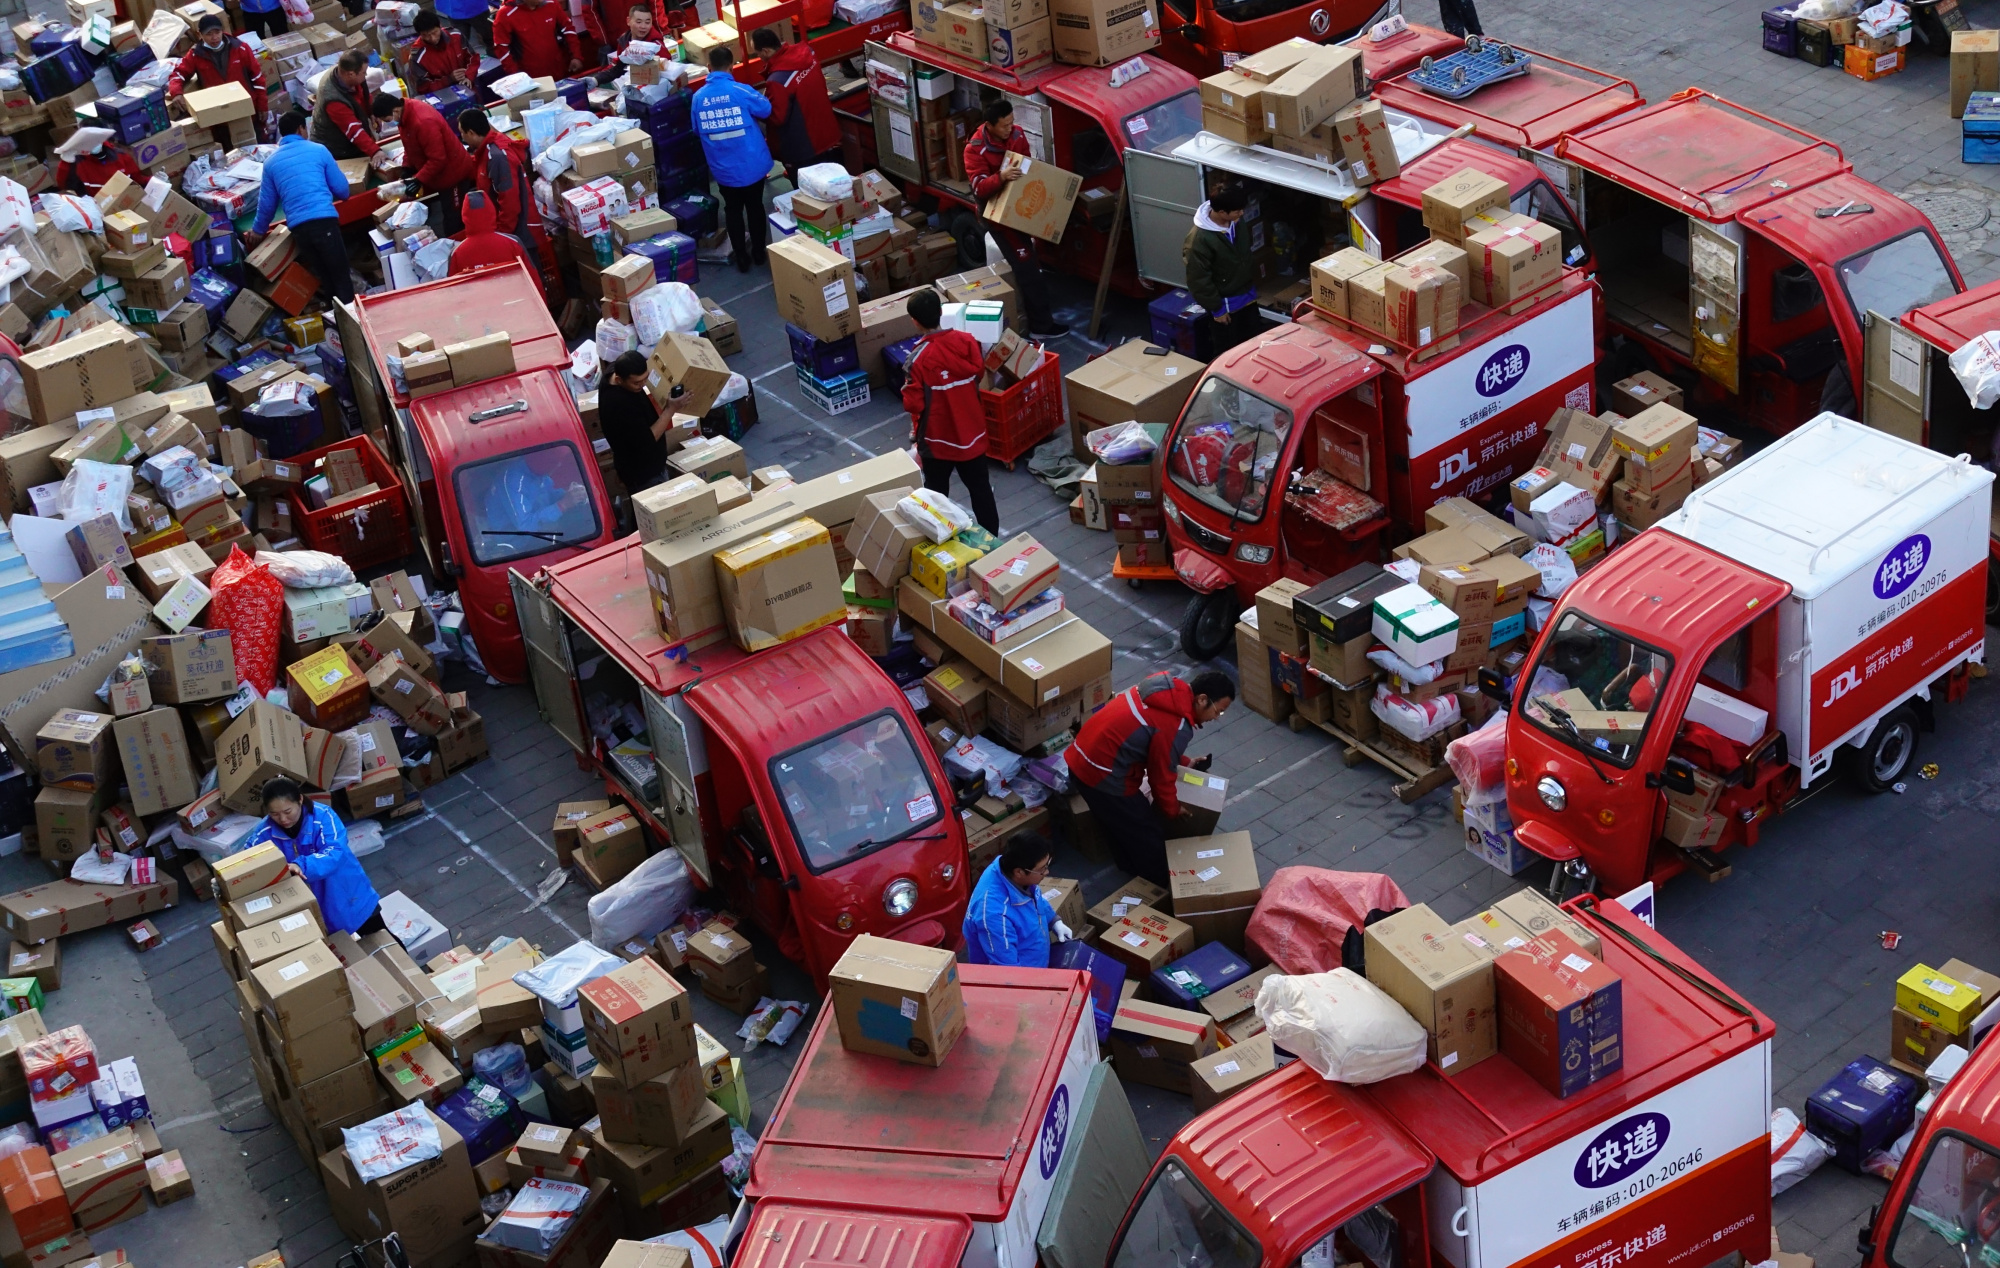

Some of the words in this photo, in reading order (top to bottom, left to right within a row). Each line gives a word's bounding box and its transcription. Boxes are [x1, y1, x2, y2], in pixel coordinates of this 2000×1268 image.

[699, 106, 741, 120] 着急送东西
[701, 116, 744, 130] 叫达达快送
[1482, 350, 1524, 392] 快递
[1459, 401, 1502, 430] 车辆编码:
[1480, 430, 1503, 446] Express
[1481, 421, 1538, 463] 京东快递
[1430, 448, 1478, 490] JDL
[701, 522, 742, 543] ARROW
[1880, 540, 1924, 594] 快递
[765, 581, 813, 606] DIY电脑旗舰店
[186, 660, 224, 673] 葵花籽油
[1865, 646, 1886, 663] Express
[1865, 635, 1914, 680] 京东快递
[1822, 665, 1862, 708] JDL
[1043, 1091, 1068, 1172] 快递
[1587, 1119, 1659, 1182] 快递
[386, 1171, 419, 1194] SUPOR
[1557, 1147, 1703, 1233] 车辆编码:010-20646
[1723, 1213, 1755, 1237] 950616
[1575, 1239, 1613, 1263] Express
[1667, 1238, 1711, 1265] www.jdl.cn
